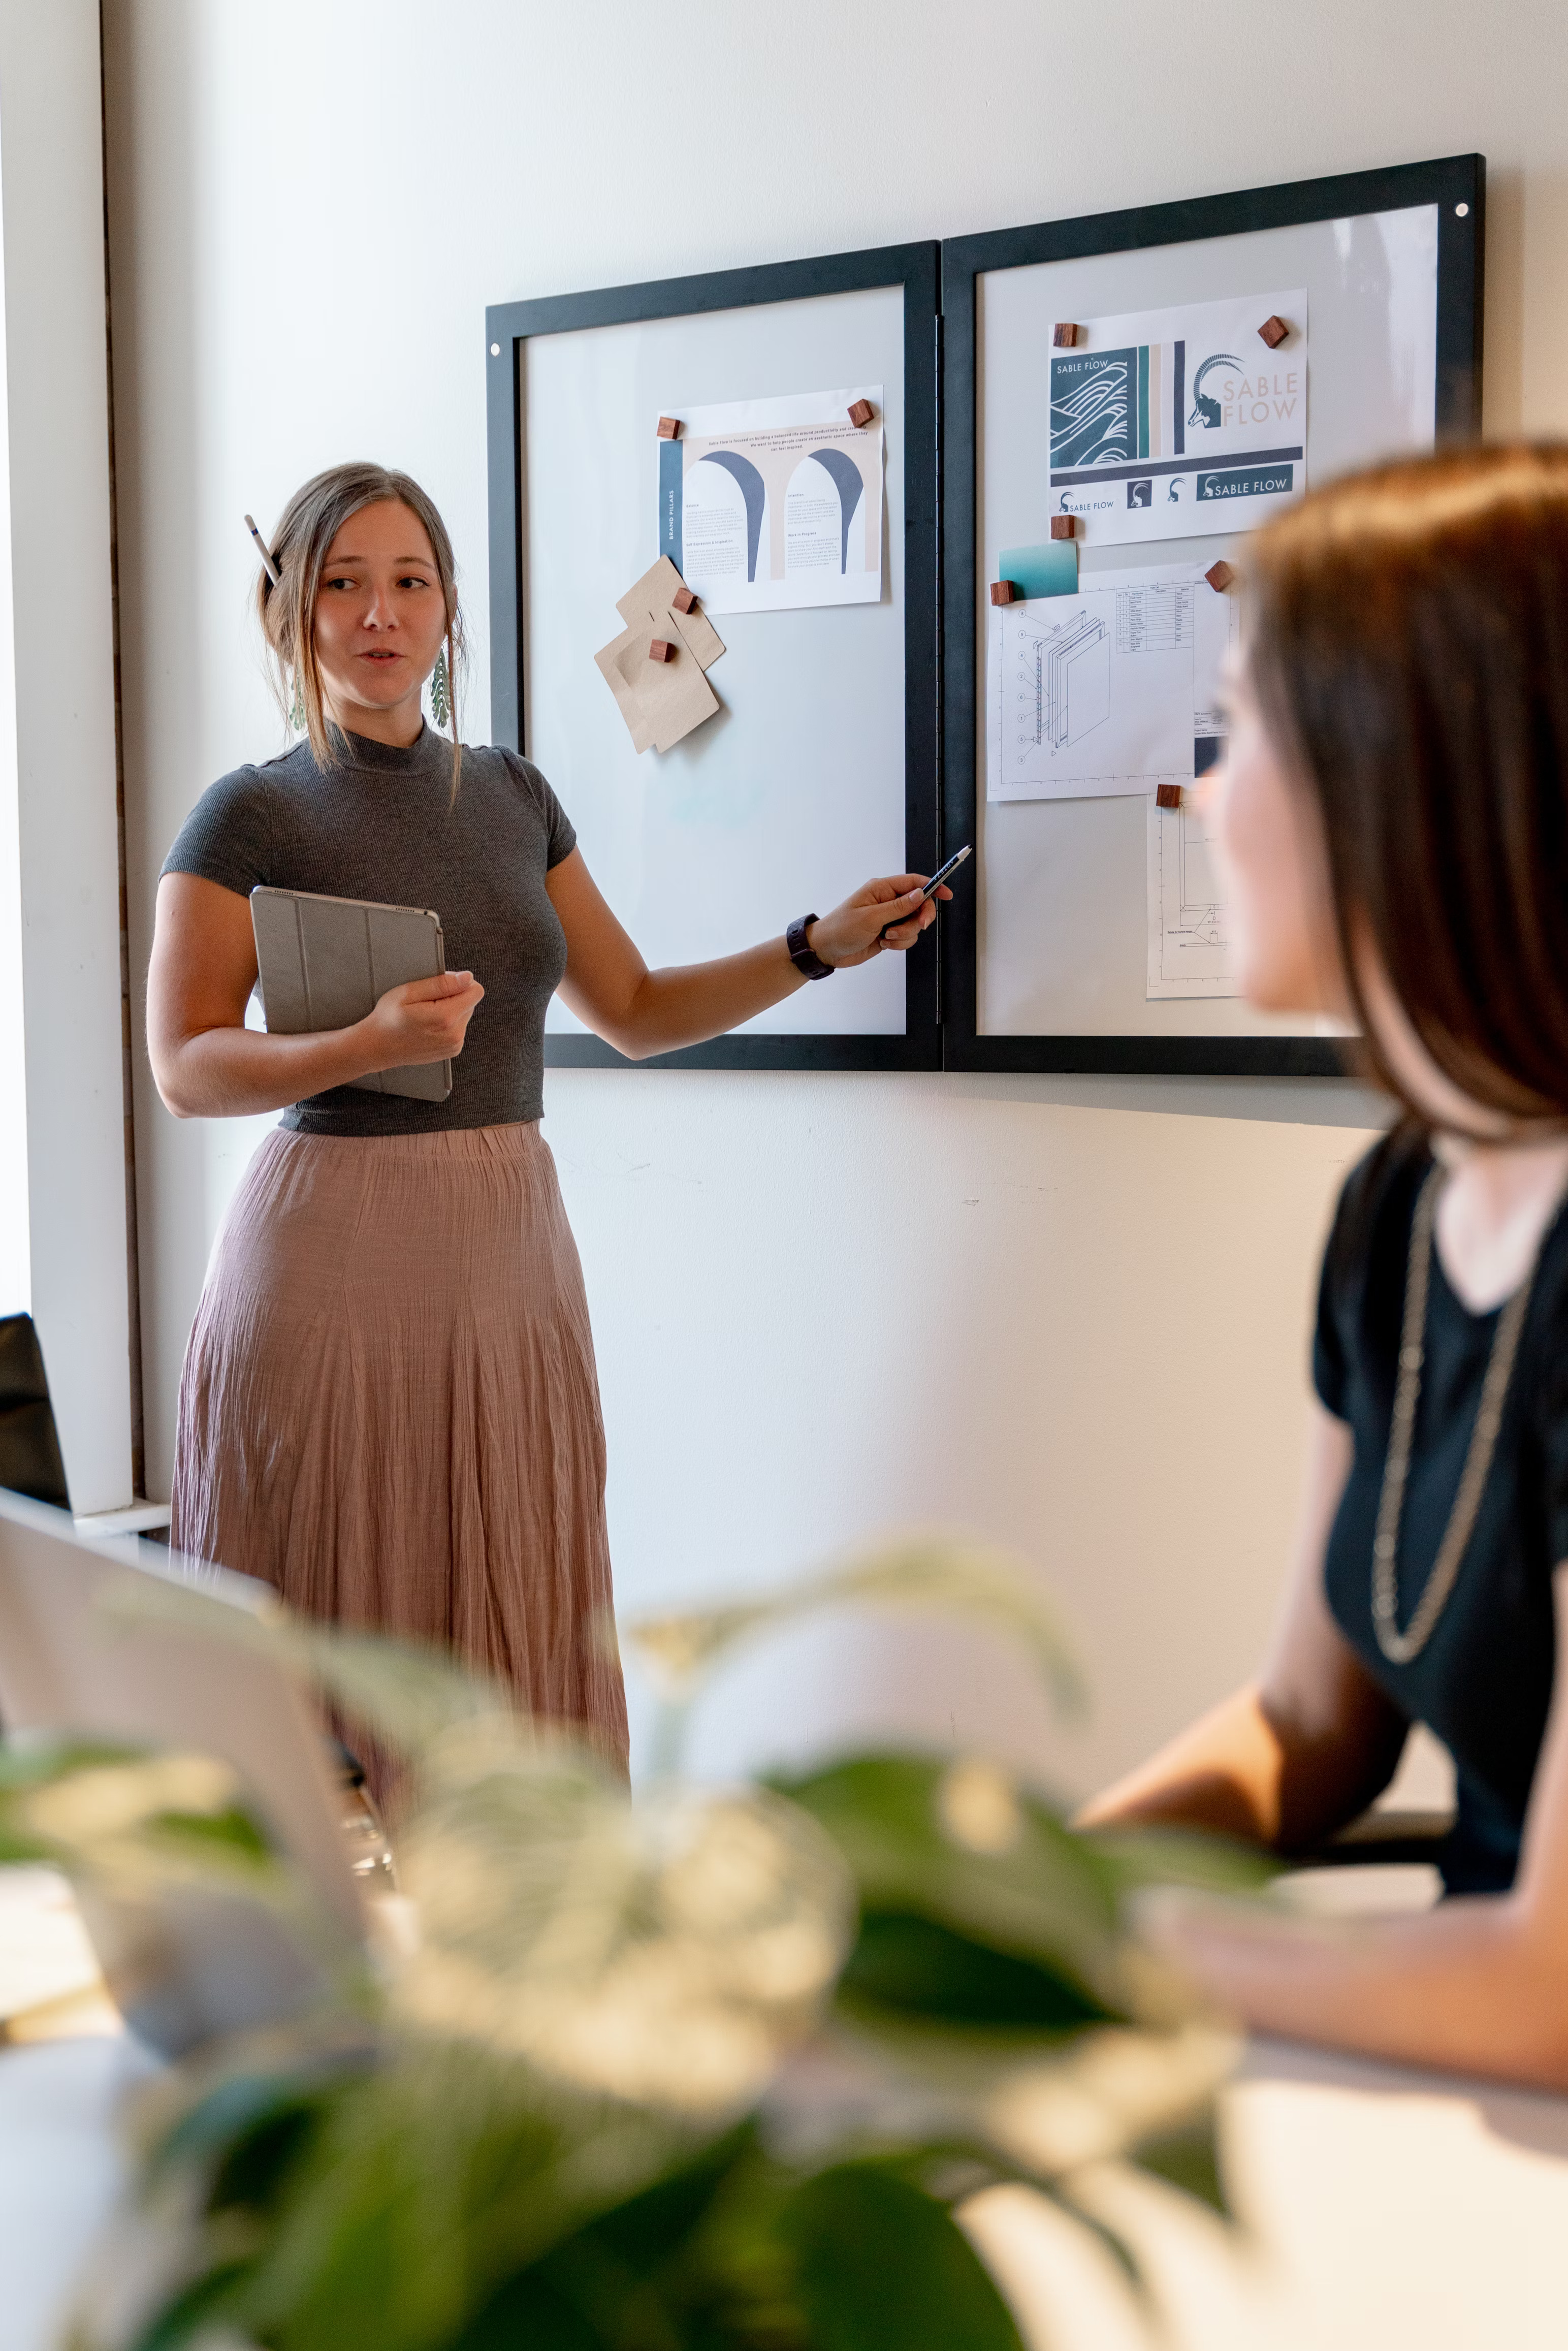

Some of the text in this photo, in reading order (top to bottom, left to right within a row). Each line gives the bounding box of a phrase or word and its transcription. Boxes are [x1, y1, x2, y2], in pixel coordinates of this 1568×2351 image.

[1057, 359, 1109, 374] SABLE FLOW
[1223, 372, 1298, 401] SABLE
[1224, 398, 1297, 426] FLOW
[1215, 478, 1287, 496] SABLE FLOW
[1070, 501, 1114, 512] SABLE FLOW
